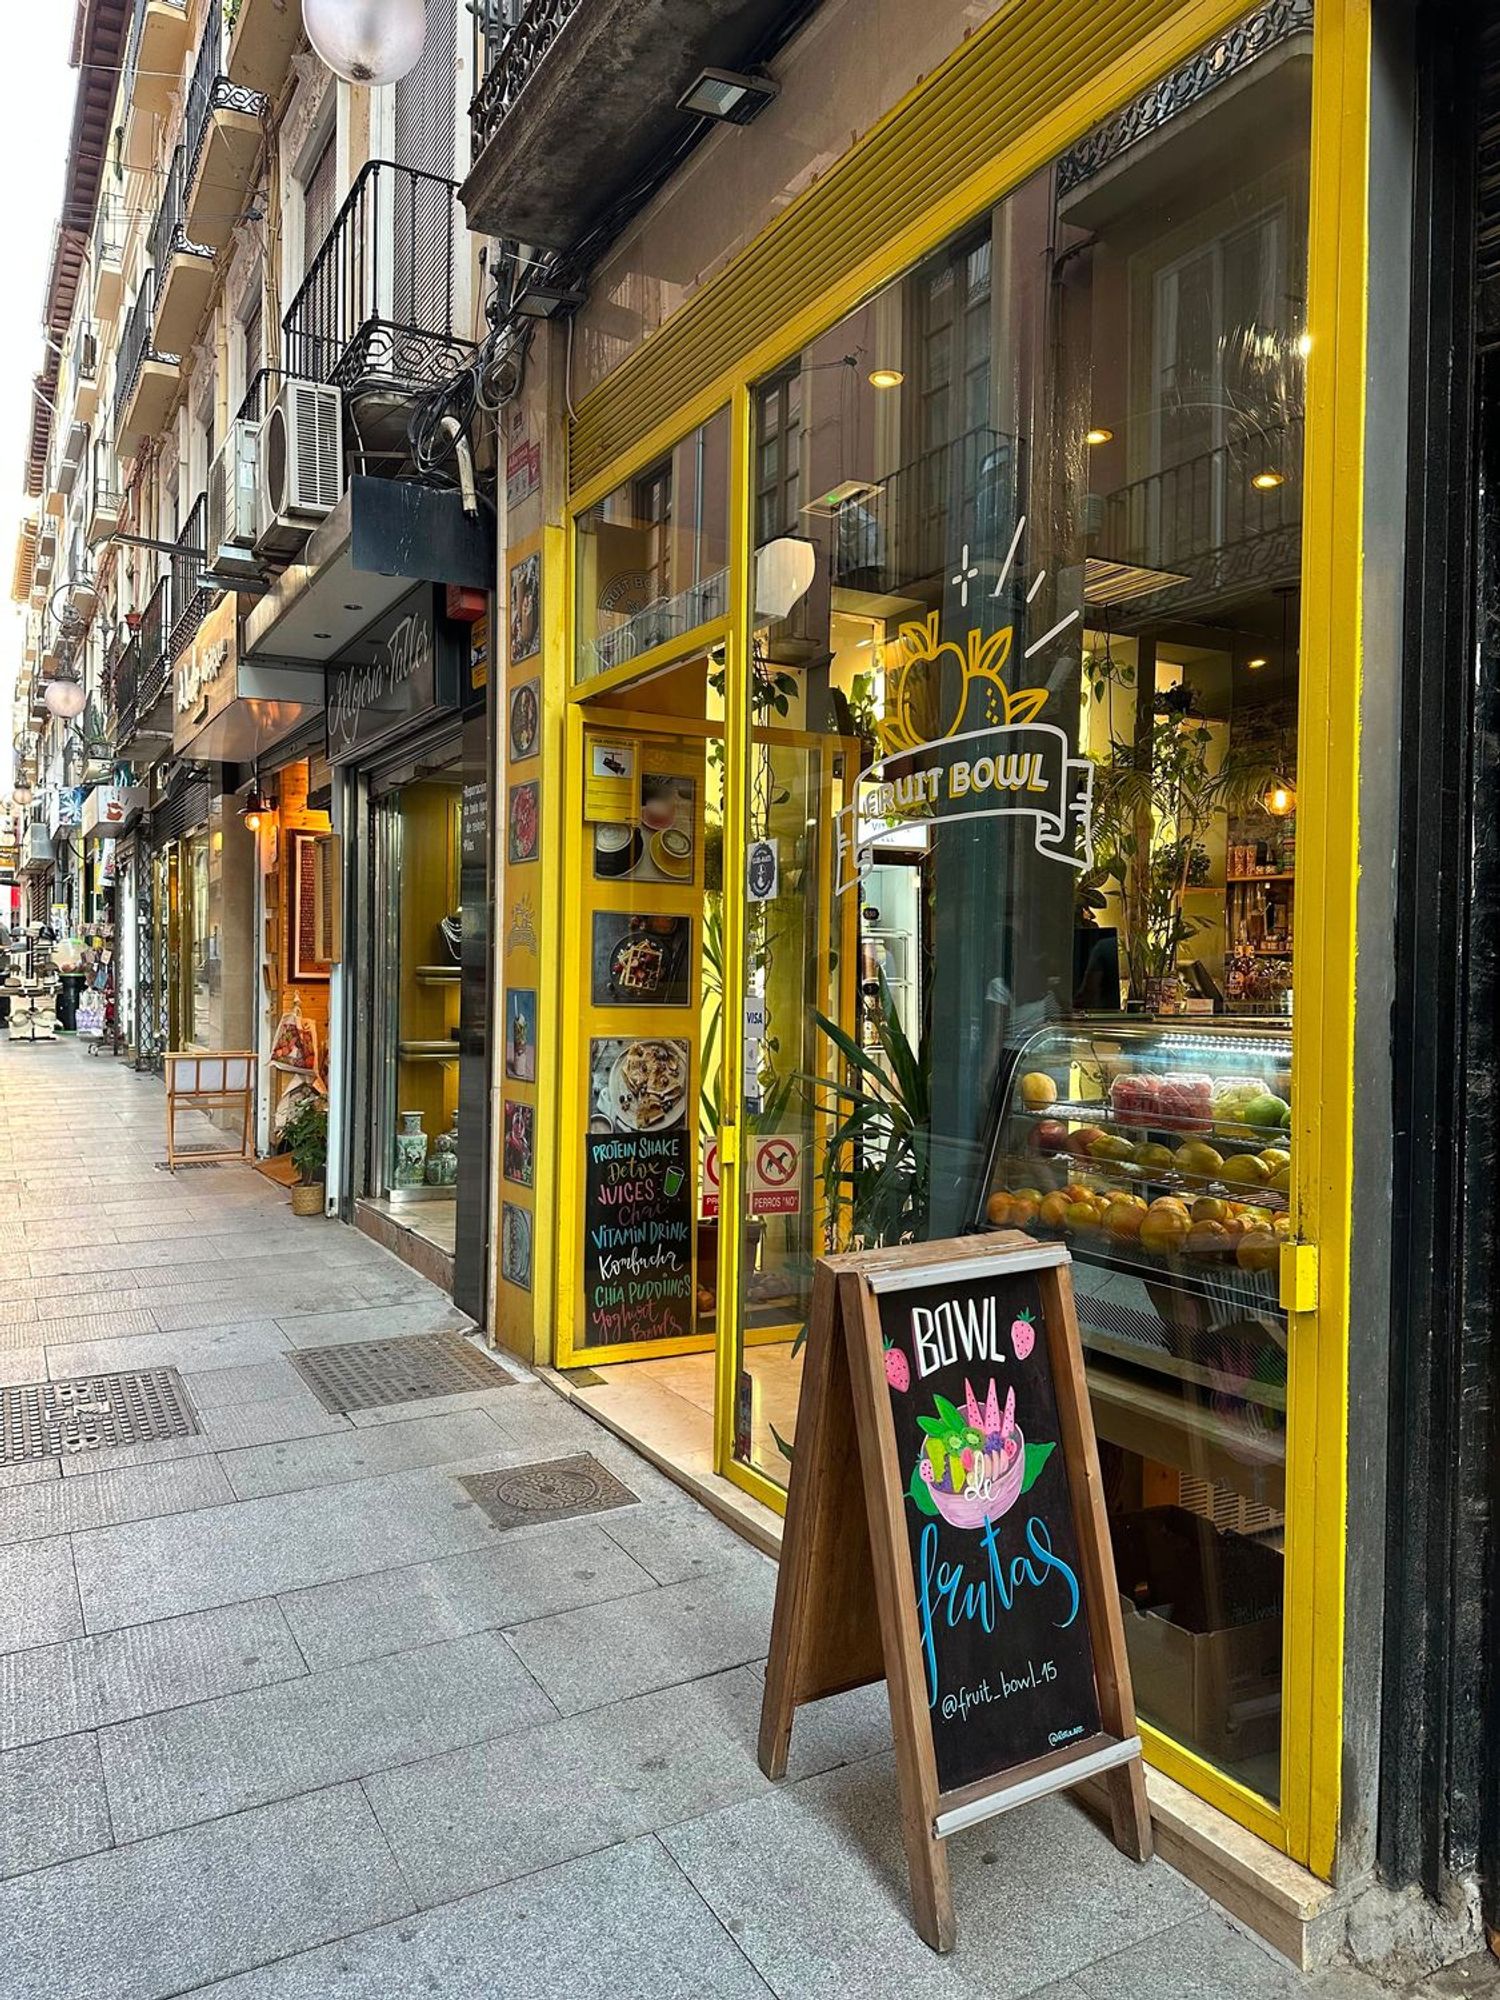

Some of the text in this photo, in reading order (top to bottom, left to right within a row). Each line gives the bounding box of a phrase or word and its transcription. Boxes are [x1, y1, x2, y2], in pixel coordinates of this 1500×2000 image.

[388, 612, 428, 694] Taller
[864, 753, 1049, 823] FRUIT BOWL
[746, 1012, 763, 1024] VISA
[593, 1137, 680, 1164] PROTEIN SHAKE
[607, 1157, 662, 1186] Detox
[597, 1178, 655, 1206] JUICES
[754, 1196, 782, 1208] PERROS
[618, 1201, 667, 1227] Chai
[592, 1219, 690, 1249] VITAMIN DRINK
[911, 1296, 1006, 1379] BOWL
[963, 1450, 997, 1501] de
[916, 1513, 1080, 1709] frutas
[941, 1660, 1058, 1722] @fruit_bowl_15
